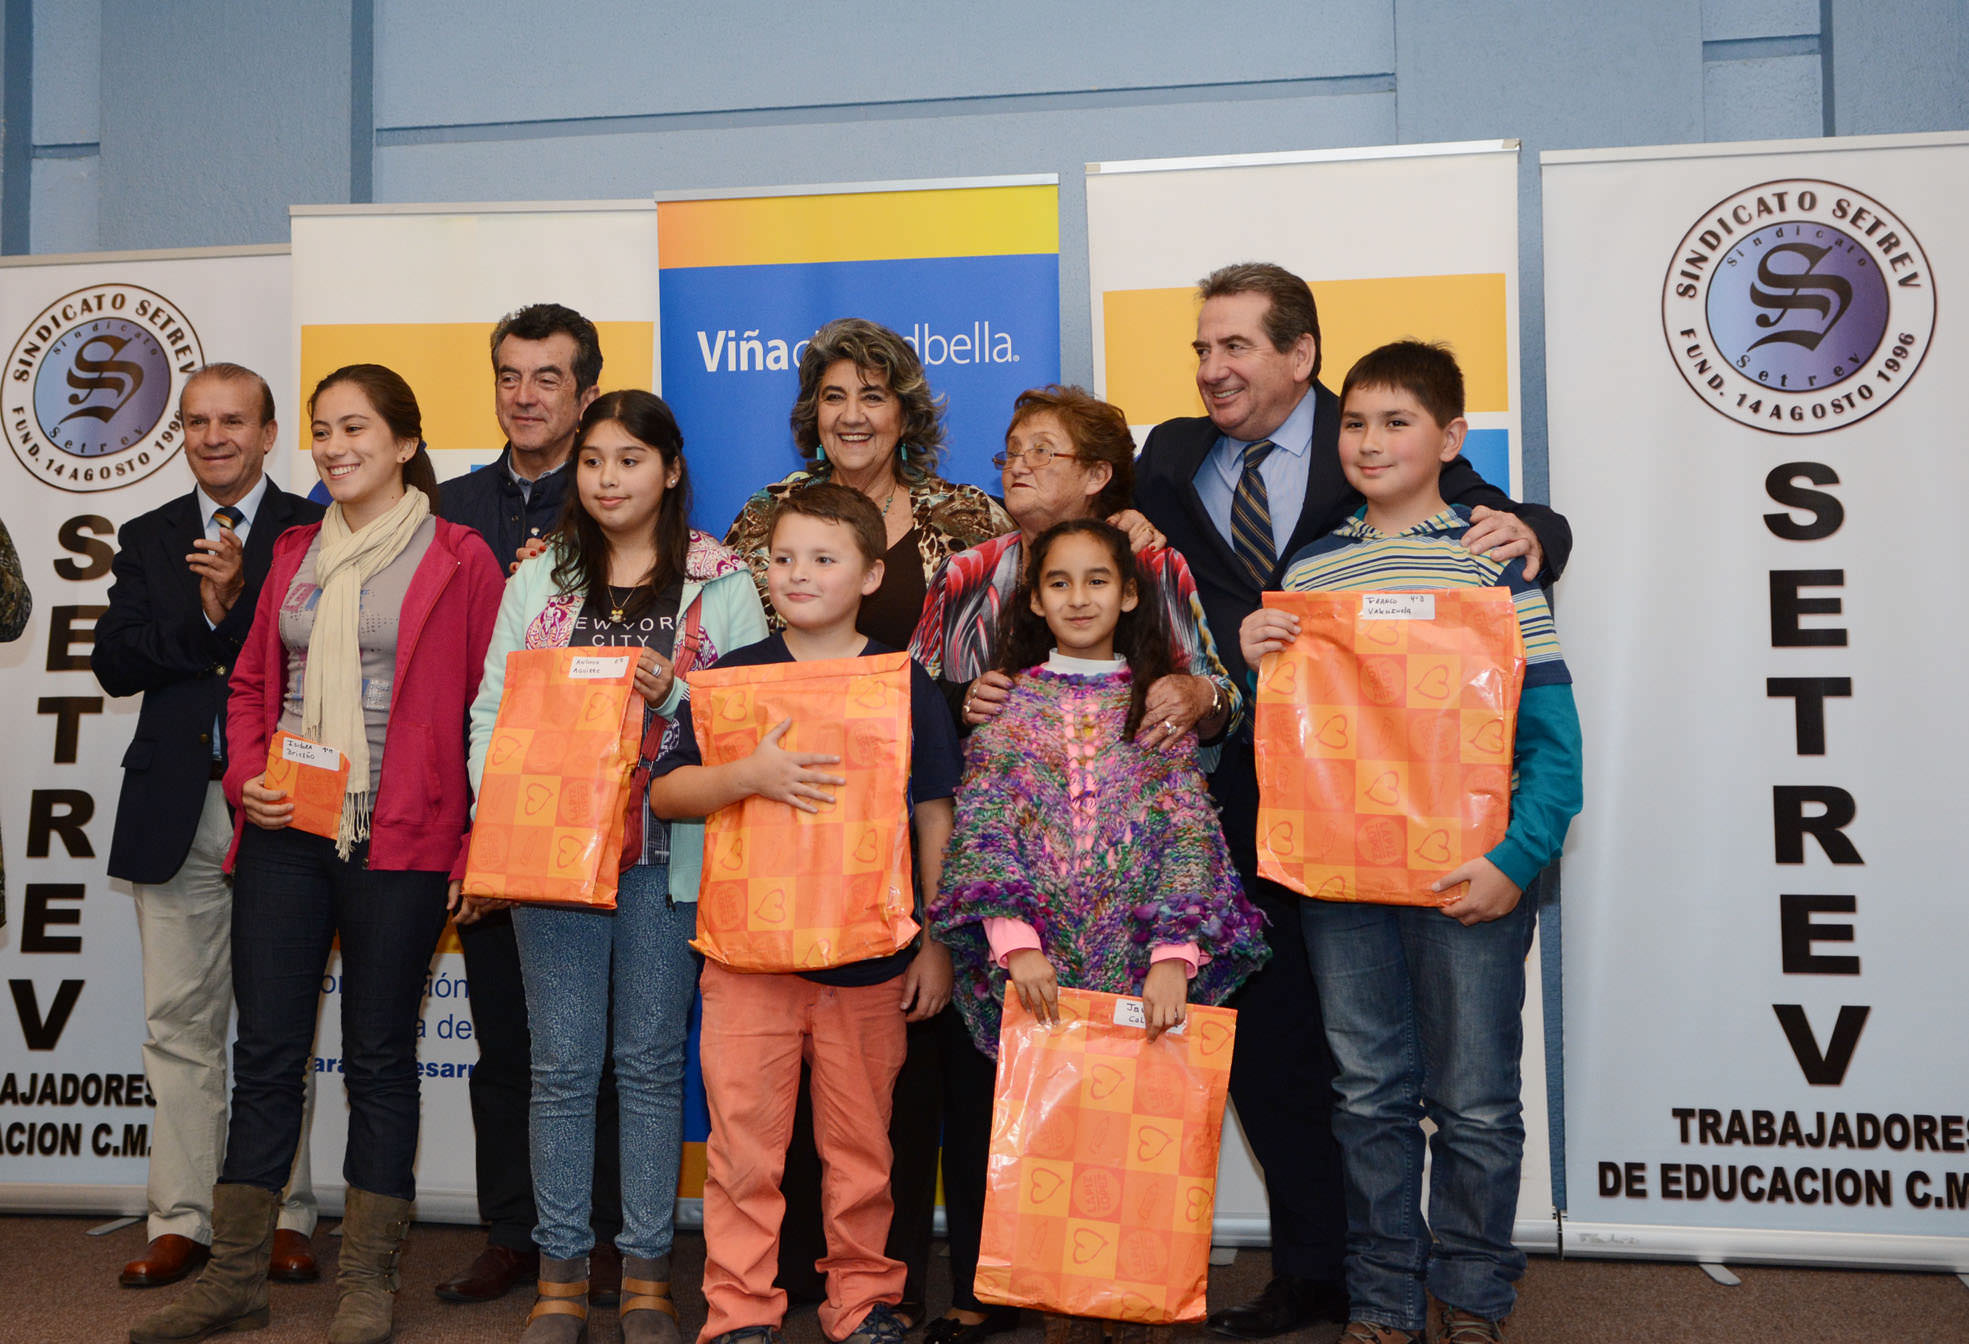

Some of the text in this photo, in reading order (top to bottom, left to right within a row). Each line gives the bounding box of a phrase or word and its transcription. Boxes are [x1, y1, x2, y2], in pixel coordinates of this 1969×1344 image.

[1676, 191, 1921, 299] SINDICATO SETREV
[13, 293, 197, 383] SINDICATO SETREV
[1680, 327, 1725, 396] FUND.
[1876, 332, 1916, 383] 1996
[1736, 352, 1861, 387] Setrev
[12, 406, 41, 462] FUND.
[575, 616, 674, 631] EW YOR
[591, 634, 649, 647] CITY
[8, 514, 115, 1051] SETREV
[1762, 461, 1871, 1086] SETREV
[437, 1013, 473, 1039] de
[0, 1121, 82, 1157] CION
[1672, 1107, 1969, 1152] TRABAJADORE
[1598, 1161, 1648, 1198] DE
[1660, 1163, 1894, 1207] EDUCACION
